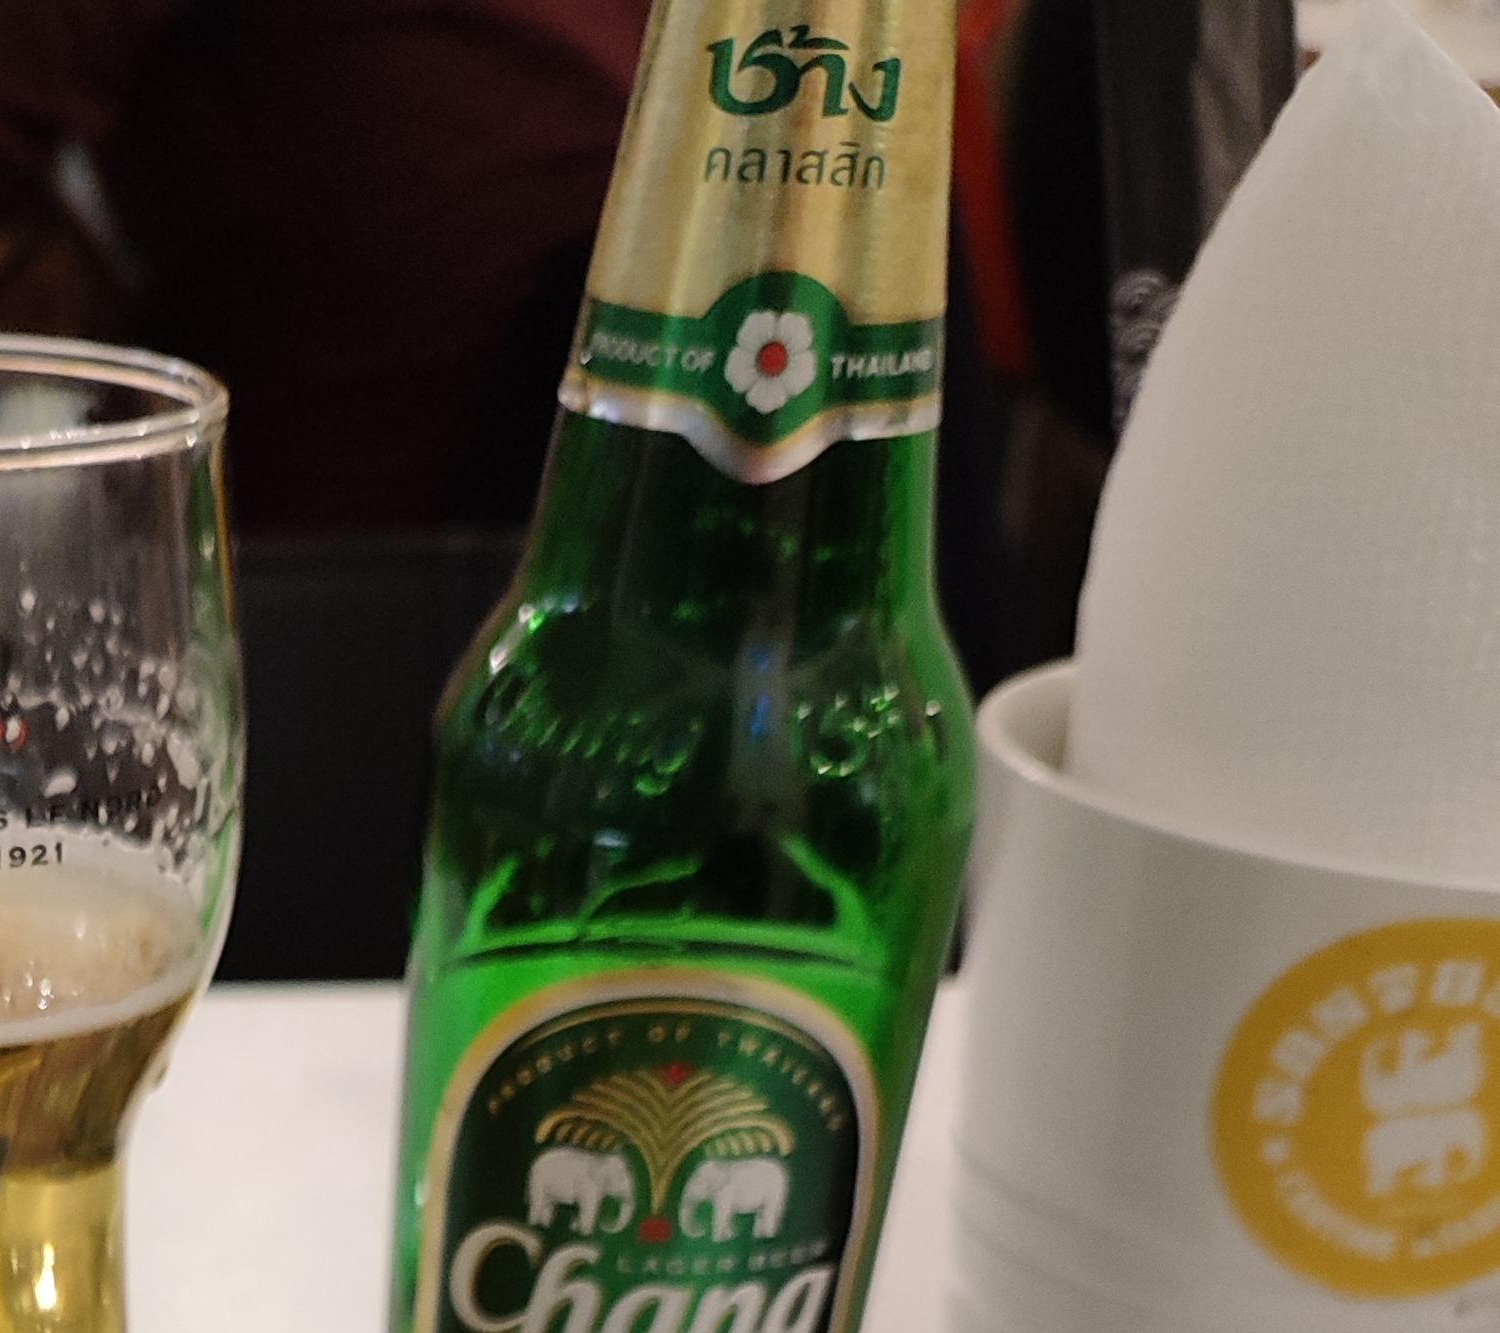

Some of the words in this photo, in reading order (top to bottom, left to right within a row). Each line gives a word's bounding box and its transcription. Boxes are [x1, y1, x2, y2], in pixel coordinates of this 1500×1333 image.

[705, 24, 901, 122] ช้าง
[681, 348, 715, 372] OF
[648, 1024, 691, 1043] OF
